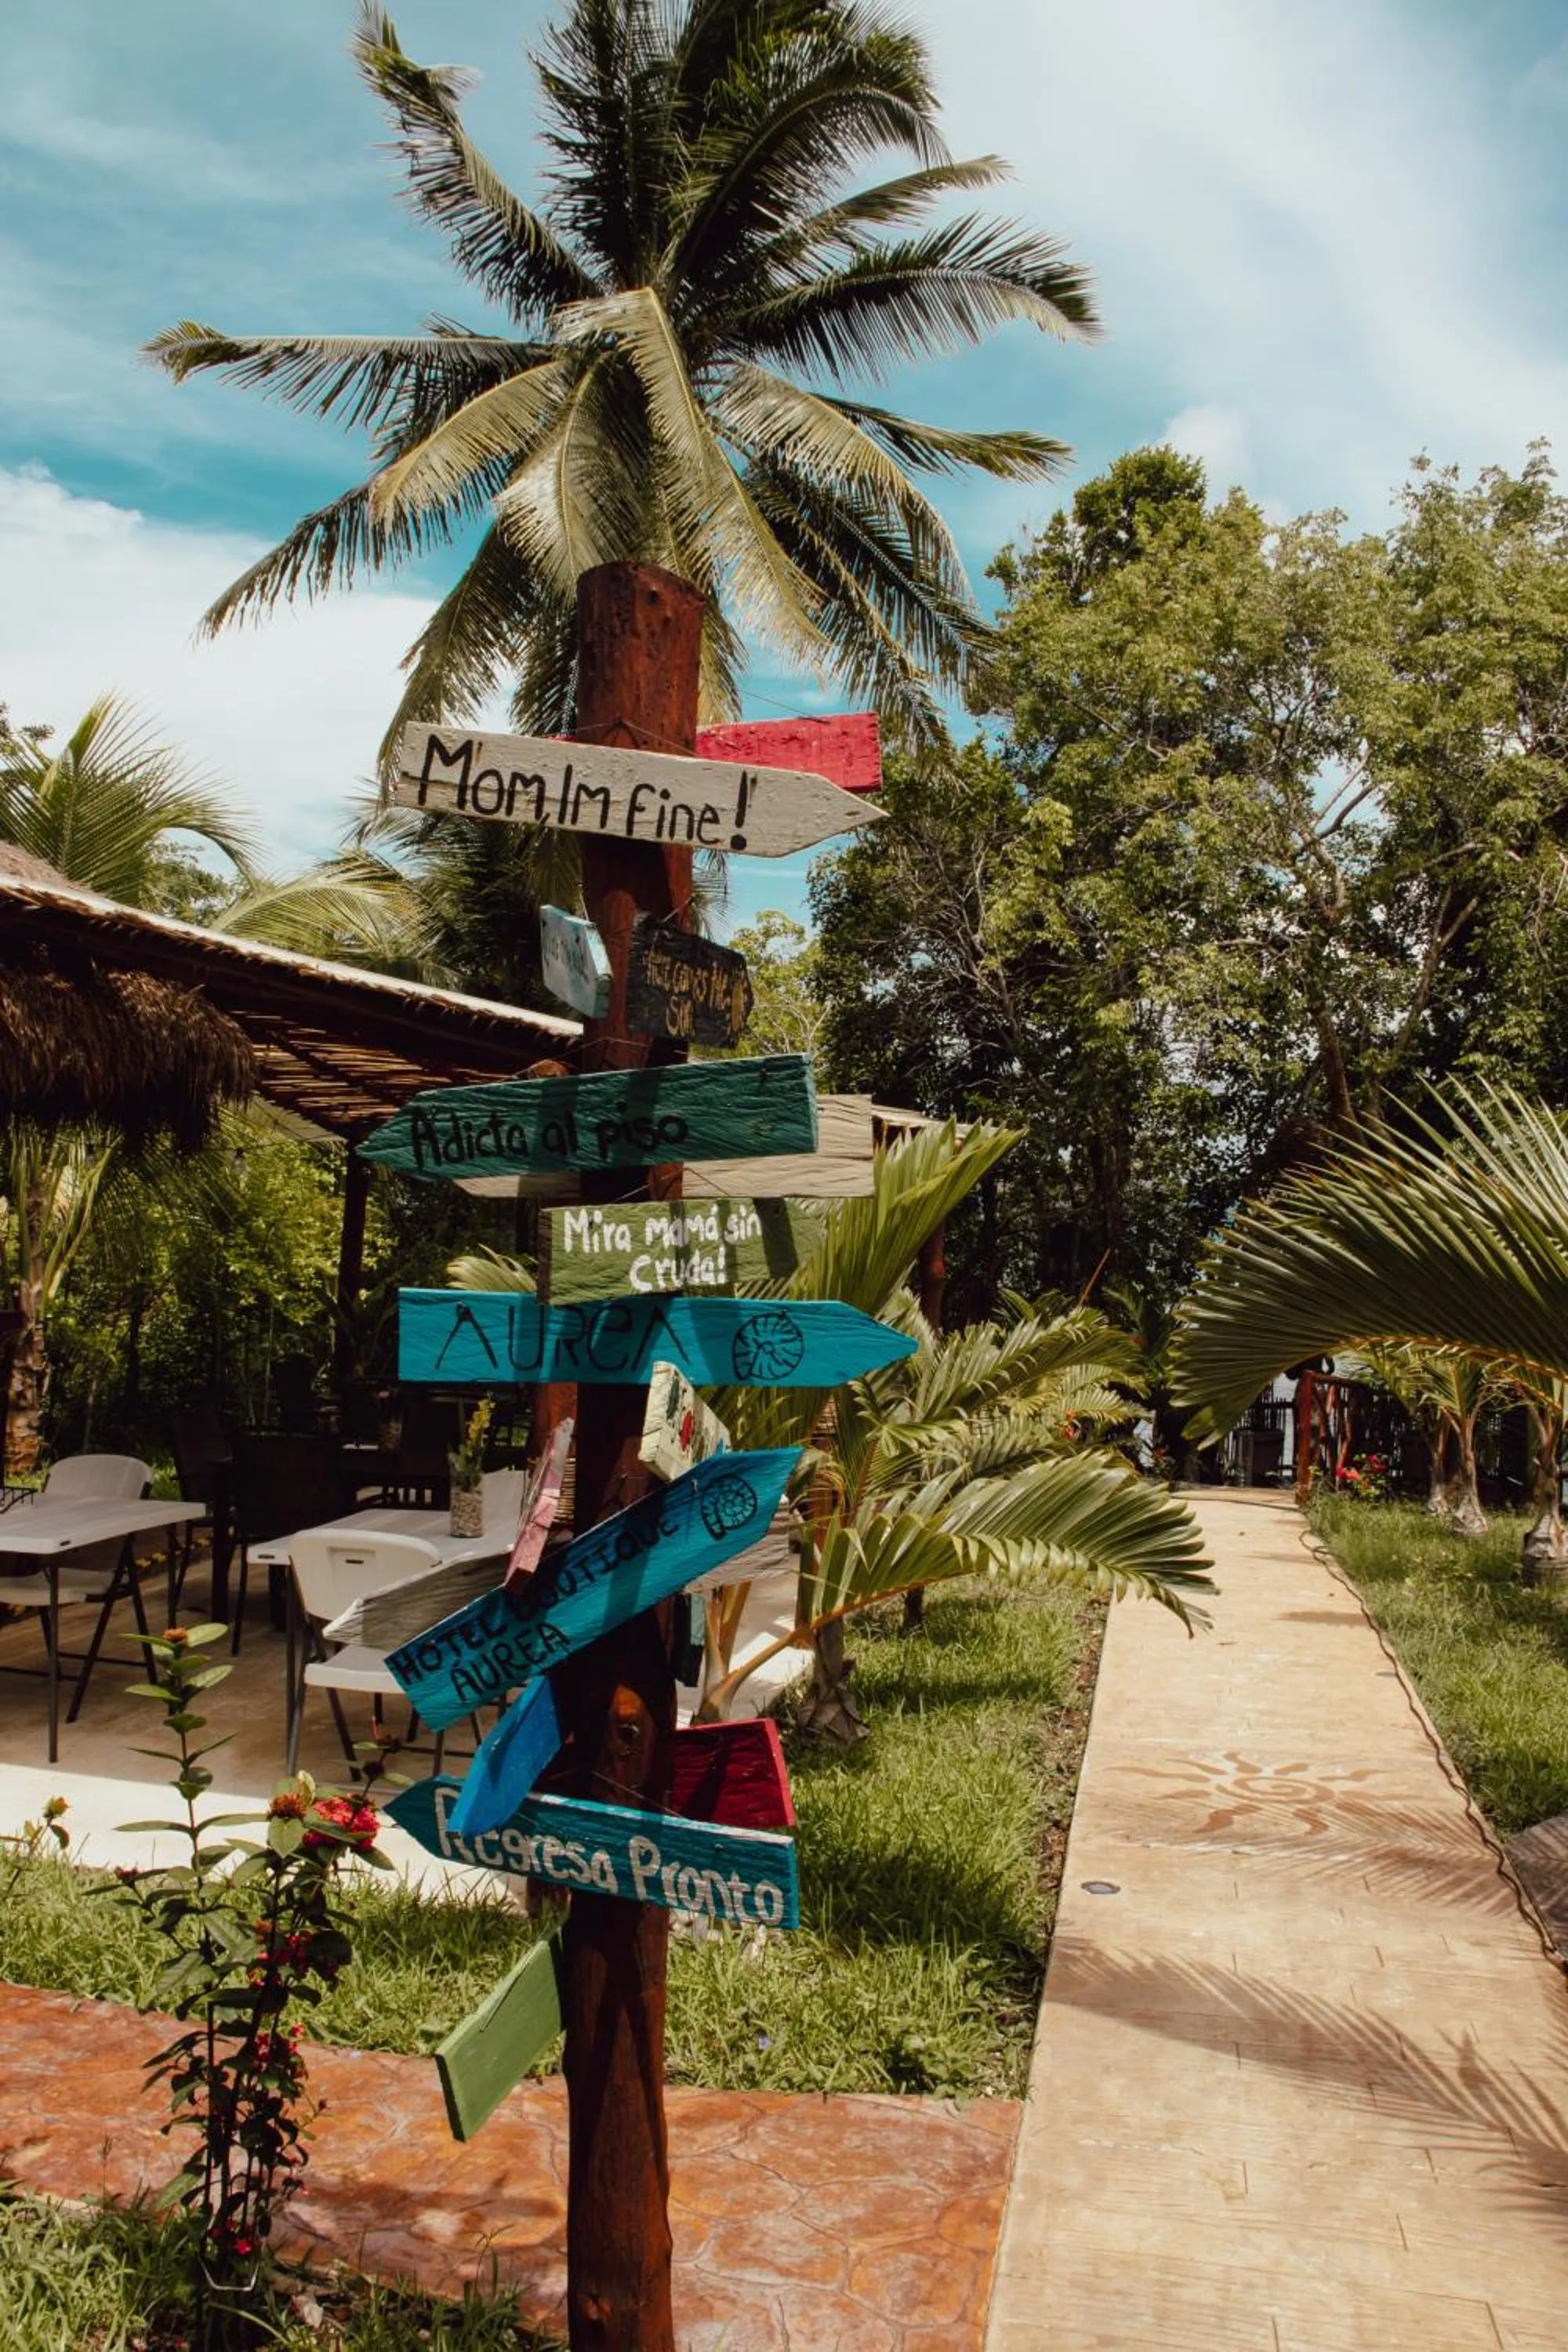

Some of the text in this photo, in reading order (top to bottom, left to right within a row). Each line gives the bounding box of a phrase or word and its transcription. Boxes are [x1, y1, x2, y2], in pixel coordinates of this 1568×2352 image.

[557, 763, 611, 829] Im
[626, 770, 747, 851] fine!
[410, 1100, 688, 1173] Adicta al piso
[563, 1203, 763, 1254] Mira mamá sin
[392, 1612, 508, 1686] HOTEL
[628, 1835, 784, 1926] Pronto
